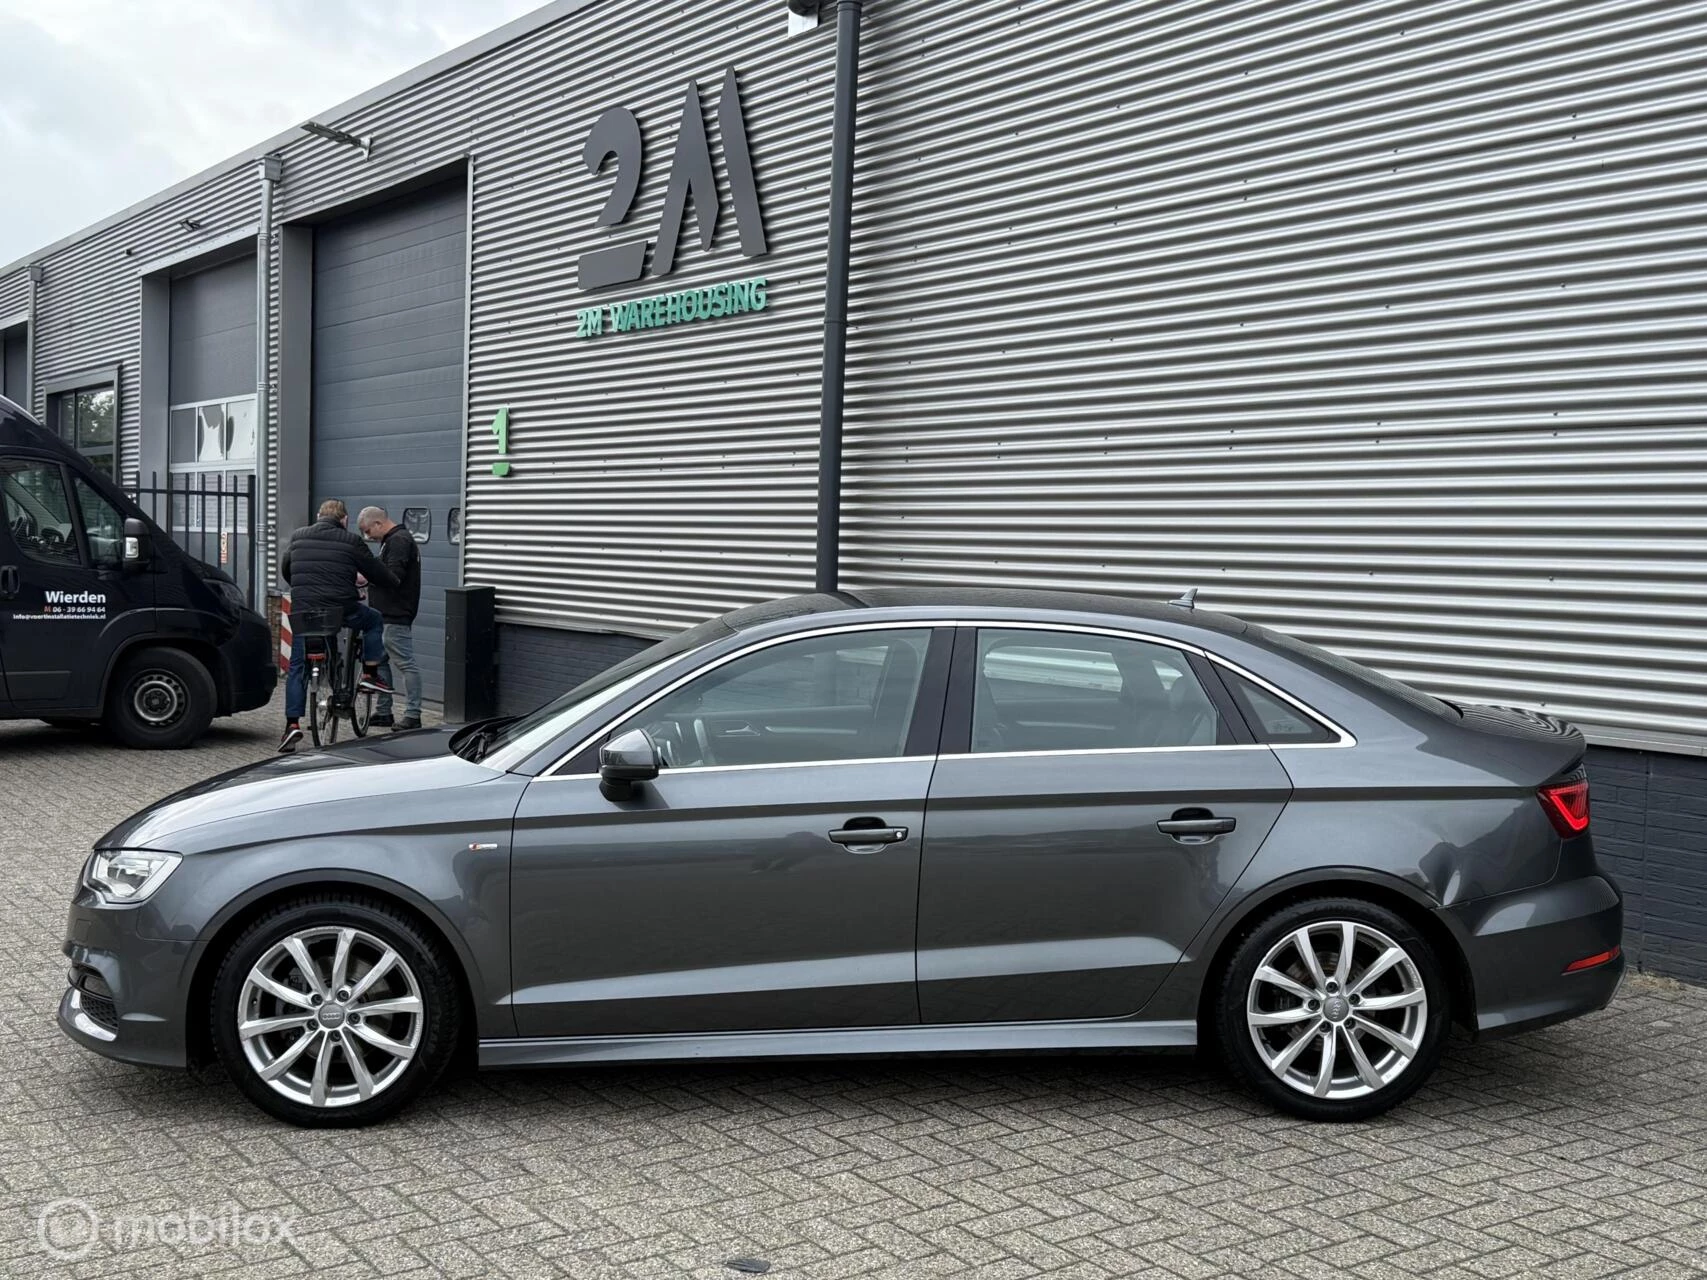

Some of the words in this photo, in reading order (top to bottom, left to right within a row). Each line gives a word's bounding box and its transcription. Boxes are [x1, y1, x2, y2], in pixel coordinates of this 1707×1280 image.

[578, 66, 768, 290] 2M
[576, 308, 603, 338] 2M
[609, 277, 768, 333] WAREHOUSING
[45, 590, 106, 603] Wierden
